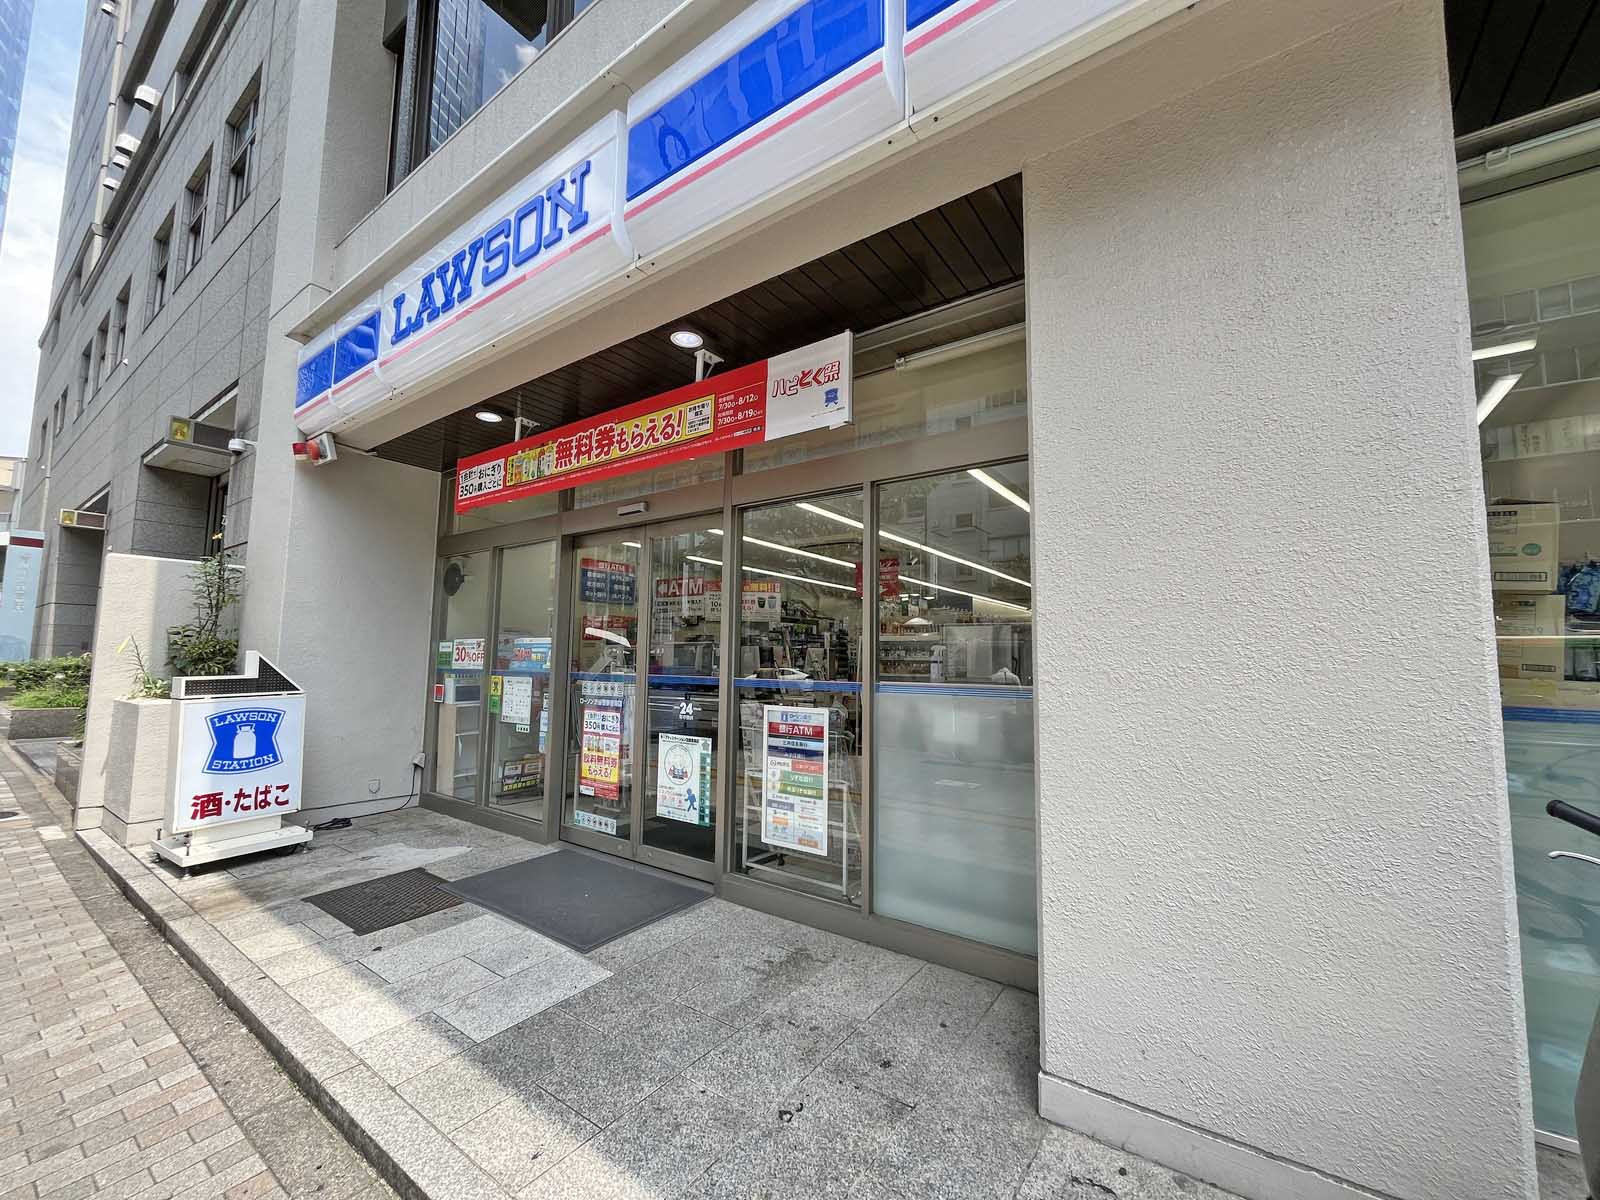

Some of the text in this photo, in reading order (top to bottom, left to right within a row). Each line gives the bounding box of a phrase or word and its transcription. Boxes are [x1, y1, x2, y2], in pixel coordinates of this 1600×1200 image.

[391, 160, 592, 345] LAWSON
[668, 577, 703, 597] ATM
[455, 646, 485, 662] 30%OFF
[680, 702, 693, 715] 24
[213, 712, 278, 727] LAWSON
[211, 753, 275, 770] STATION
[191, 783, 290, 820] 酒・たばこ
